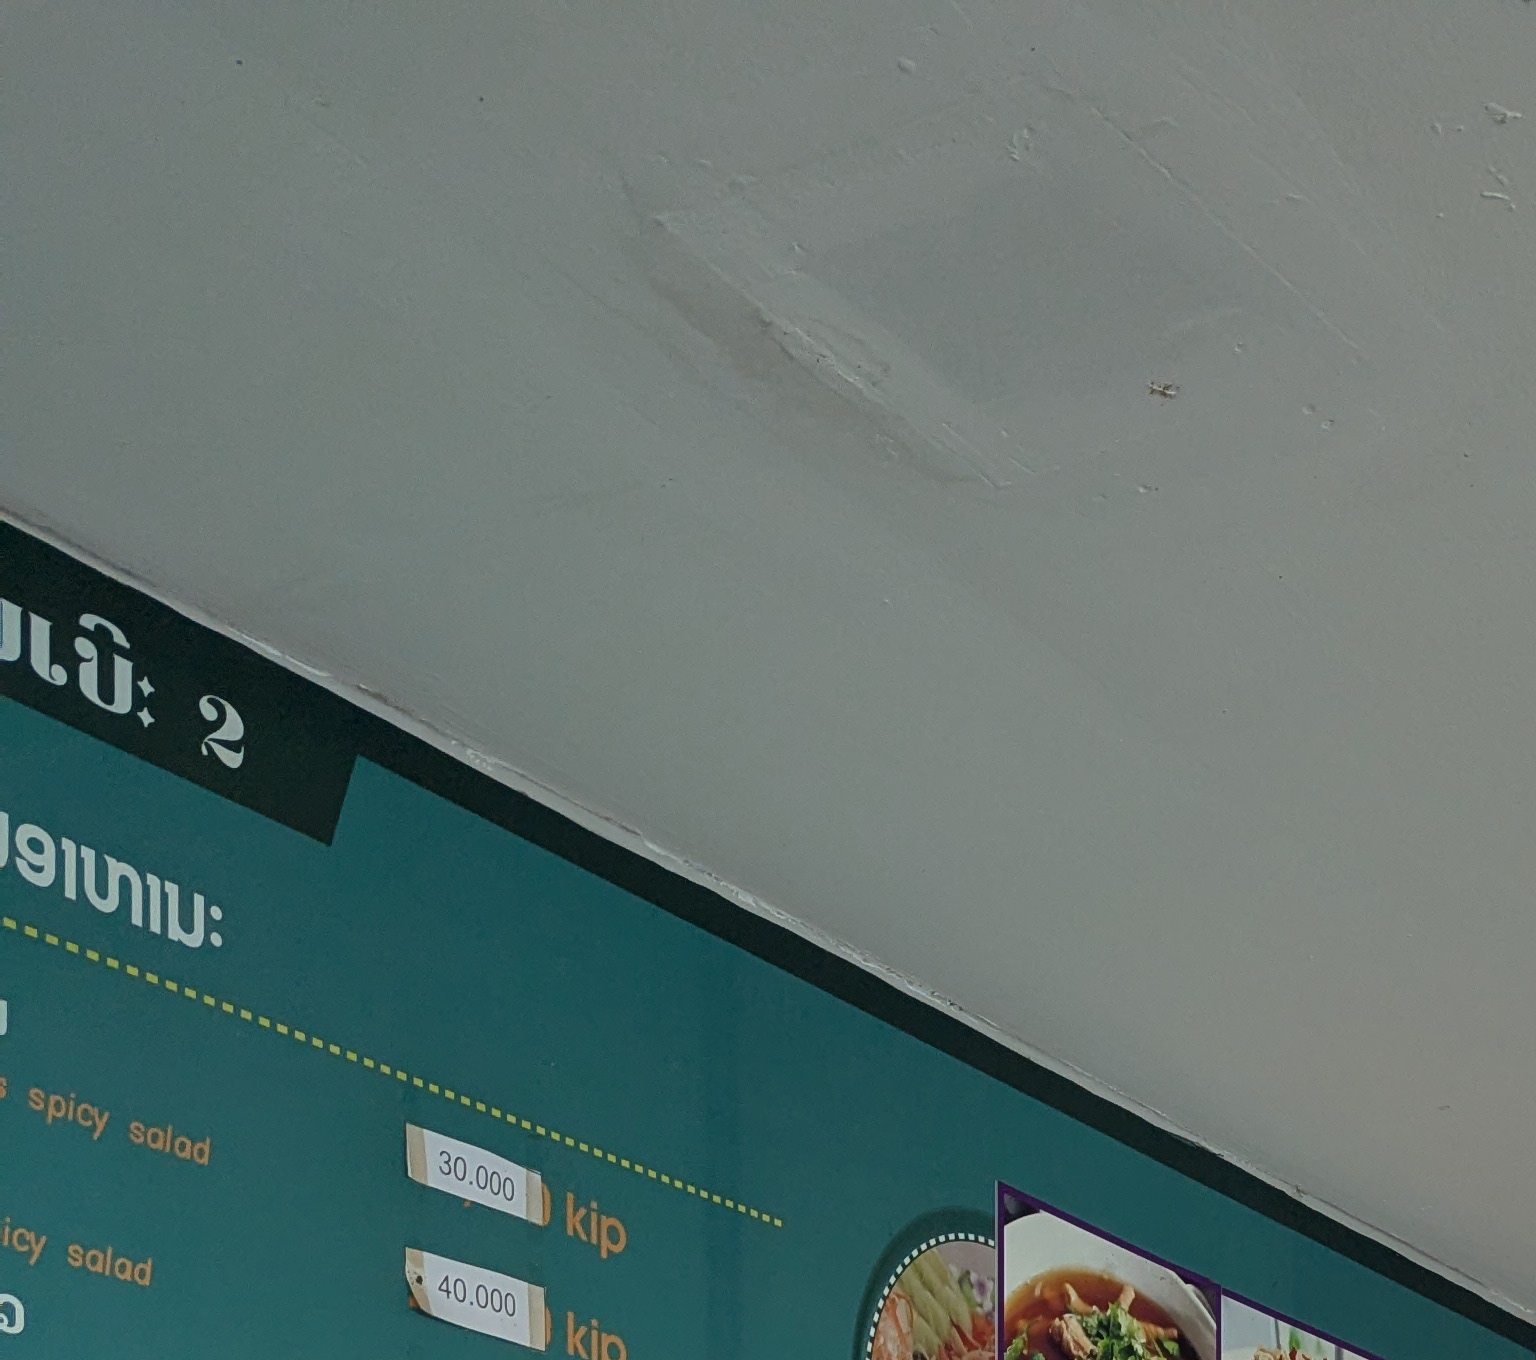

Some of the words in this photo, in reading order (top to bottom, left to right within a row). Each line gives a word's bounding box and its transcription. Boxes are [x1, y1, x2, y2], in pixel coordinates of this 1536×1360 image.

[199, 694, 245, 769] 2
[0, 811, 223, 948] ອາຫານ:
[28, 1086, 109, 1140] spicy
[129, 1119, 211, 1165] salad
[438, 1150, 516, 1202] 30.000
[566, 1192, 627, 1259] kip
[68, 1243, 153, 1286] salad
[438, 1275, 517, 1317] 40.000
